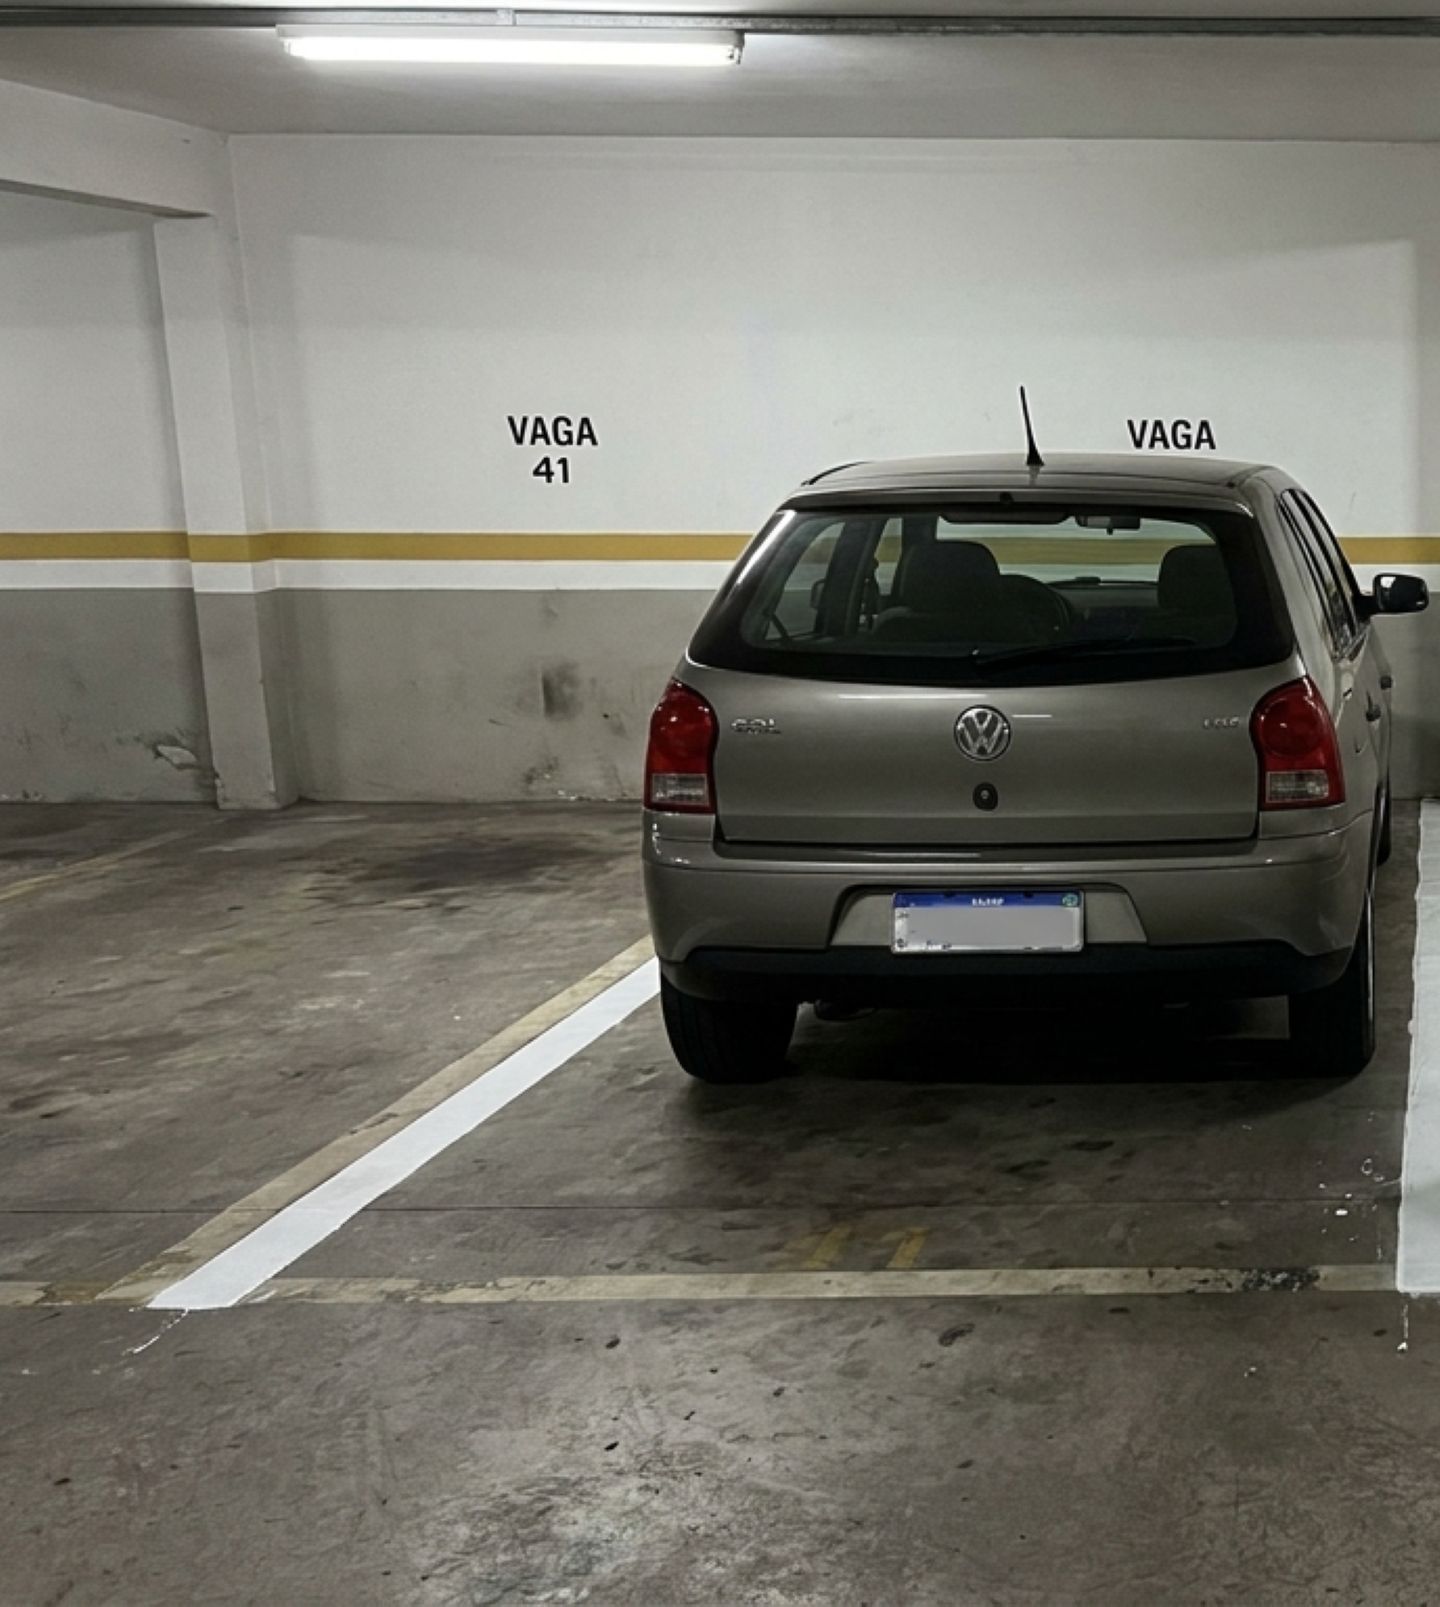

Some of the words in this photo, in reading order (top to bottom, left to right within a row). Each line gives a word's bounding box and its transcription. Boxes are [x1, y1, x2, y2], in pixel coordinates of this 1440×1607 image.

[507, 415, 599, 446] VAGA
[1127, 419, 1217, 450] VAGA
[532, 457, 569, 484] 41
